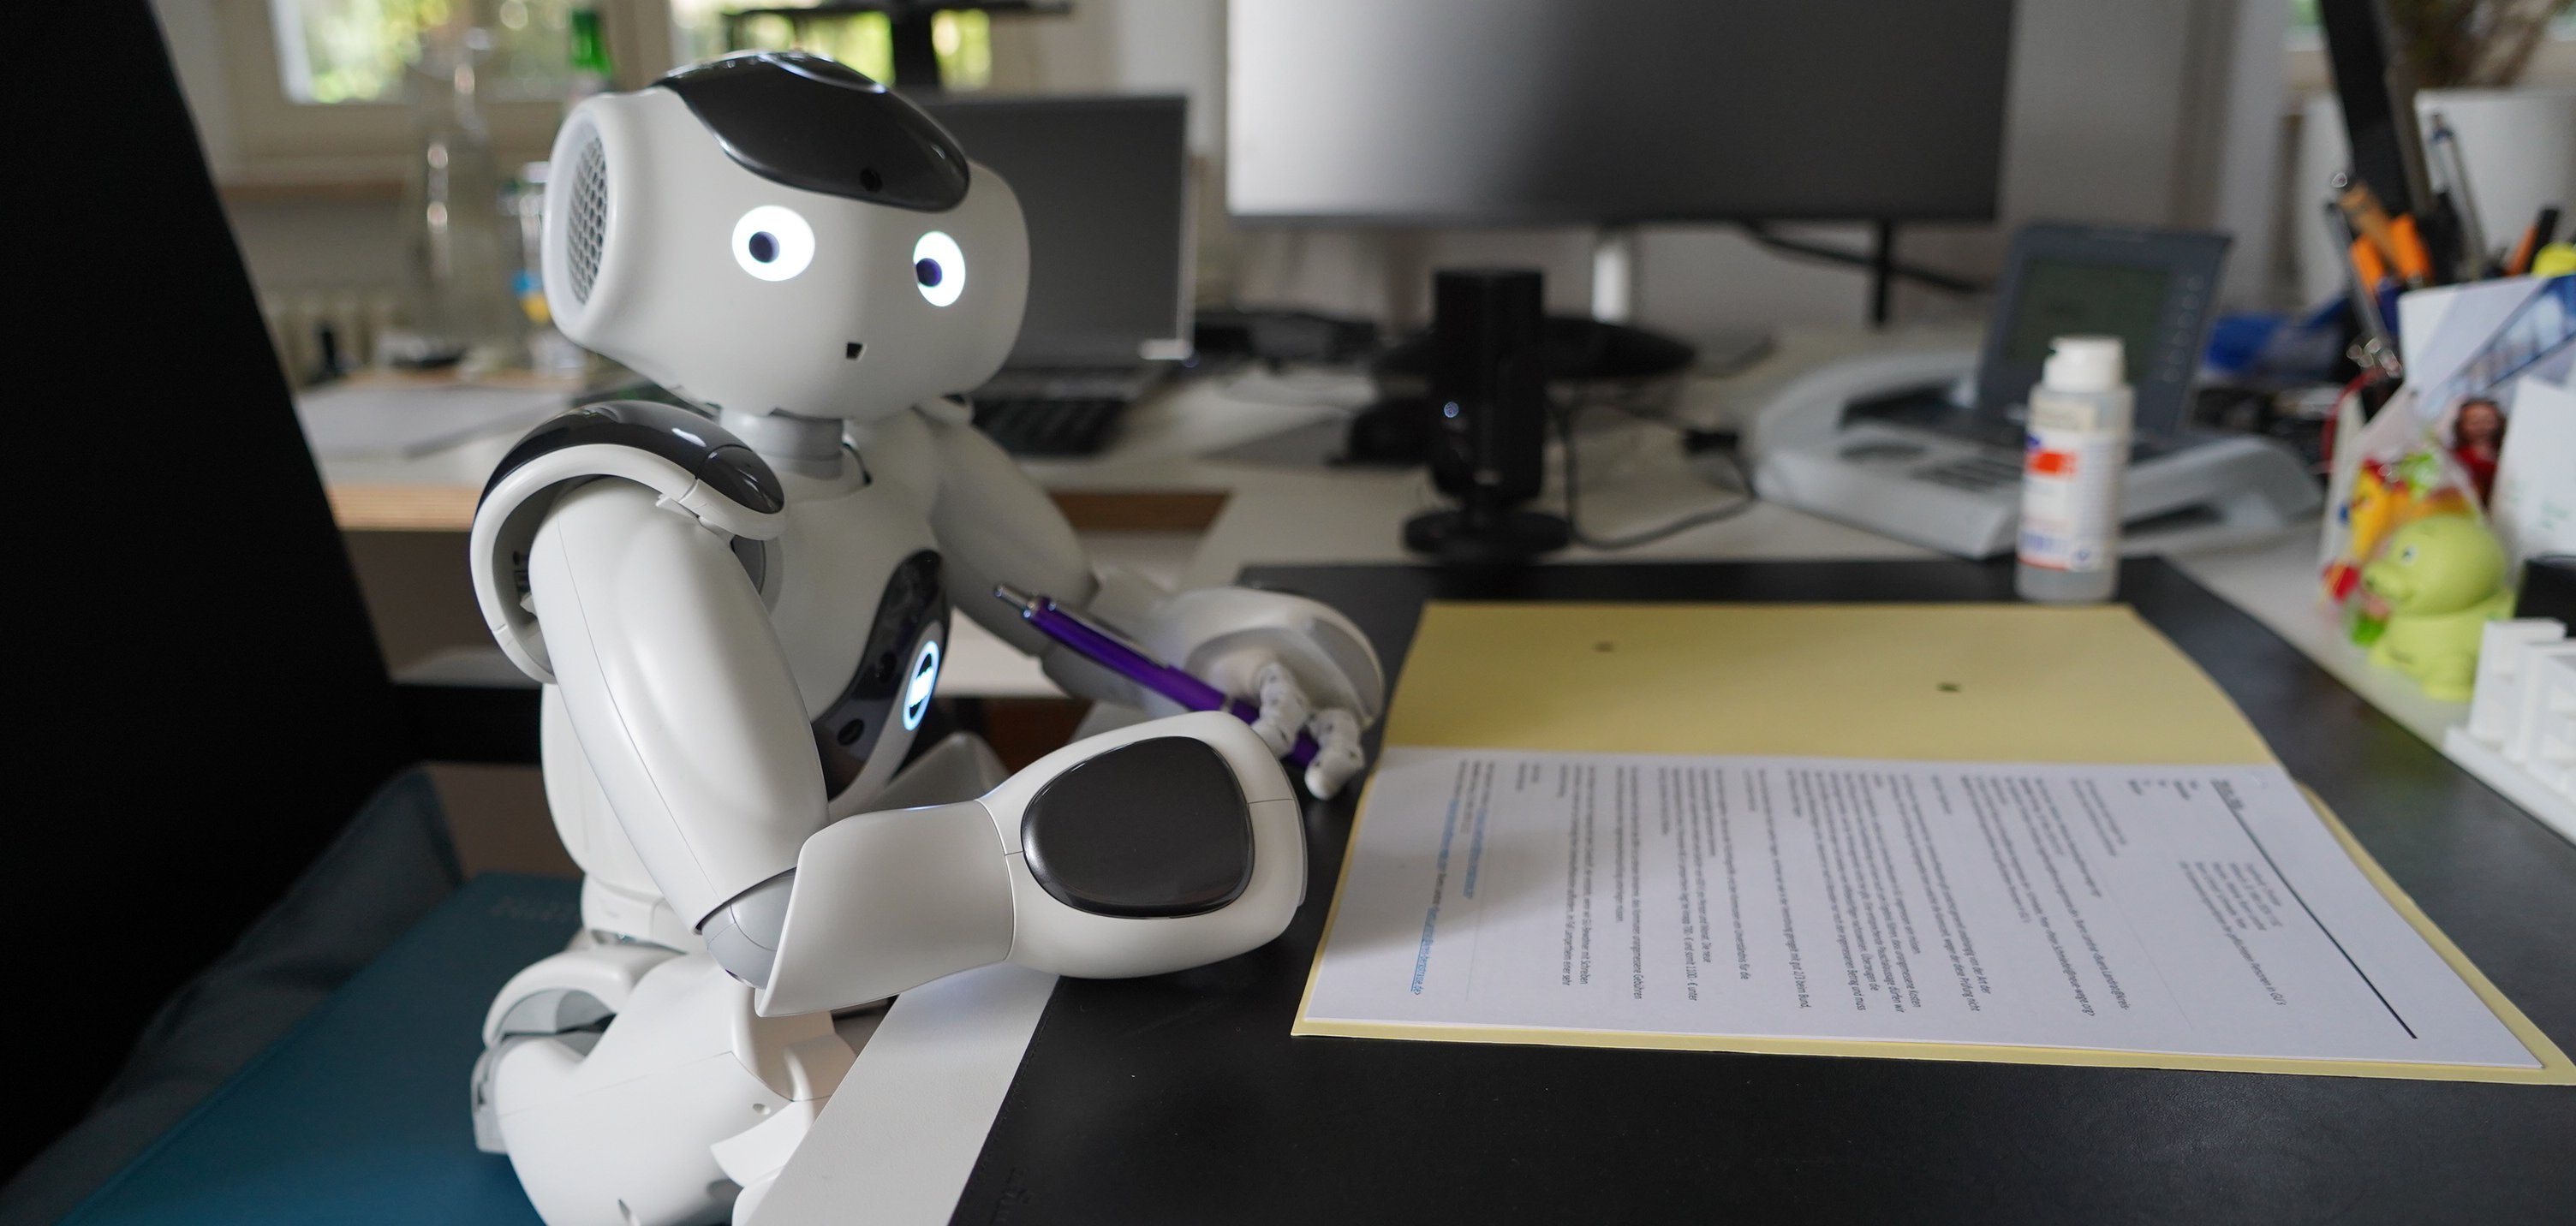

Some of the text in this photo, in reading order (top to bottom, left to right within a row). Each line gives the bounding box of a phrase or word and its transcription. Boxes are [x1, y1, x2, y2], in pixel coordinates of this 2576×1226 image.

[1685, 951, 1696, 966] somit
[1562, 961, 1571, 974] einer
[1579, 960, 1591, 985] Schreiben
[1953, 963, 1966, 977] diese
[1562, 974, 1572, 986] sehr
[1632, 974, 1645, 1000] Gebühren
[1795, 980, 1807, 993] beim
[1687, 986, 1698, 1002] unter
[1846, 969, 1860, 986] Betrag
[1855, 997, 1867, 1011] muss
[1887, 986, 1903, 1003] dürfen
[1959, 978, 1974, 998] Prüfung
[1798, 994, 1812, 1009] Bund,
[1908, 990, 1922, 1008] Kosten
[1966, 997, 1981, 1012] nicht
